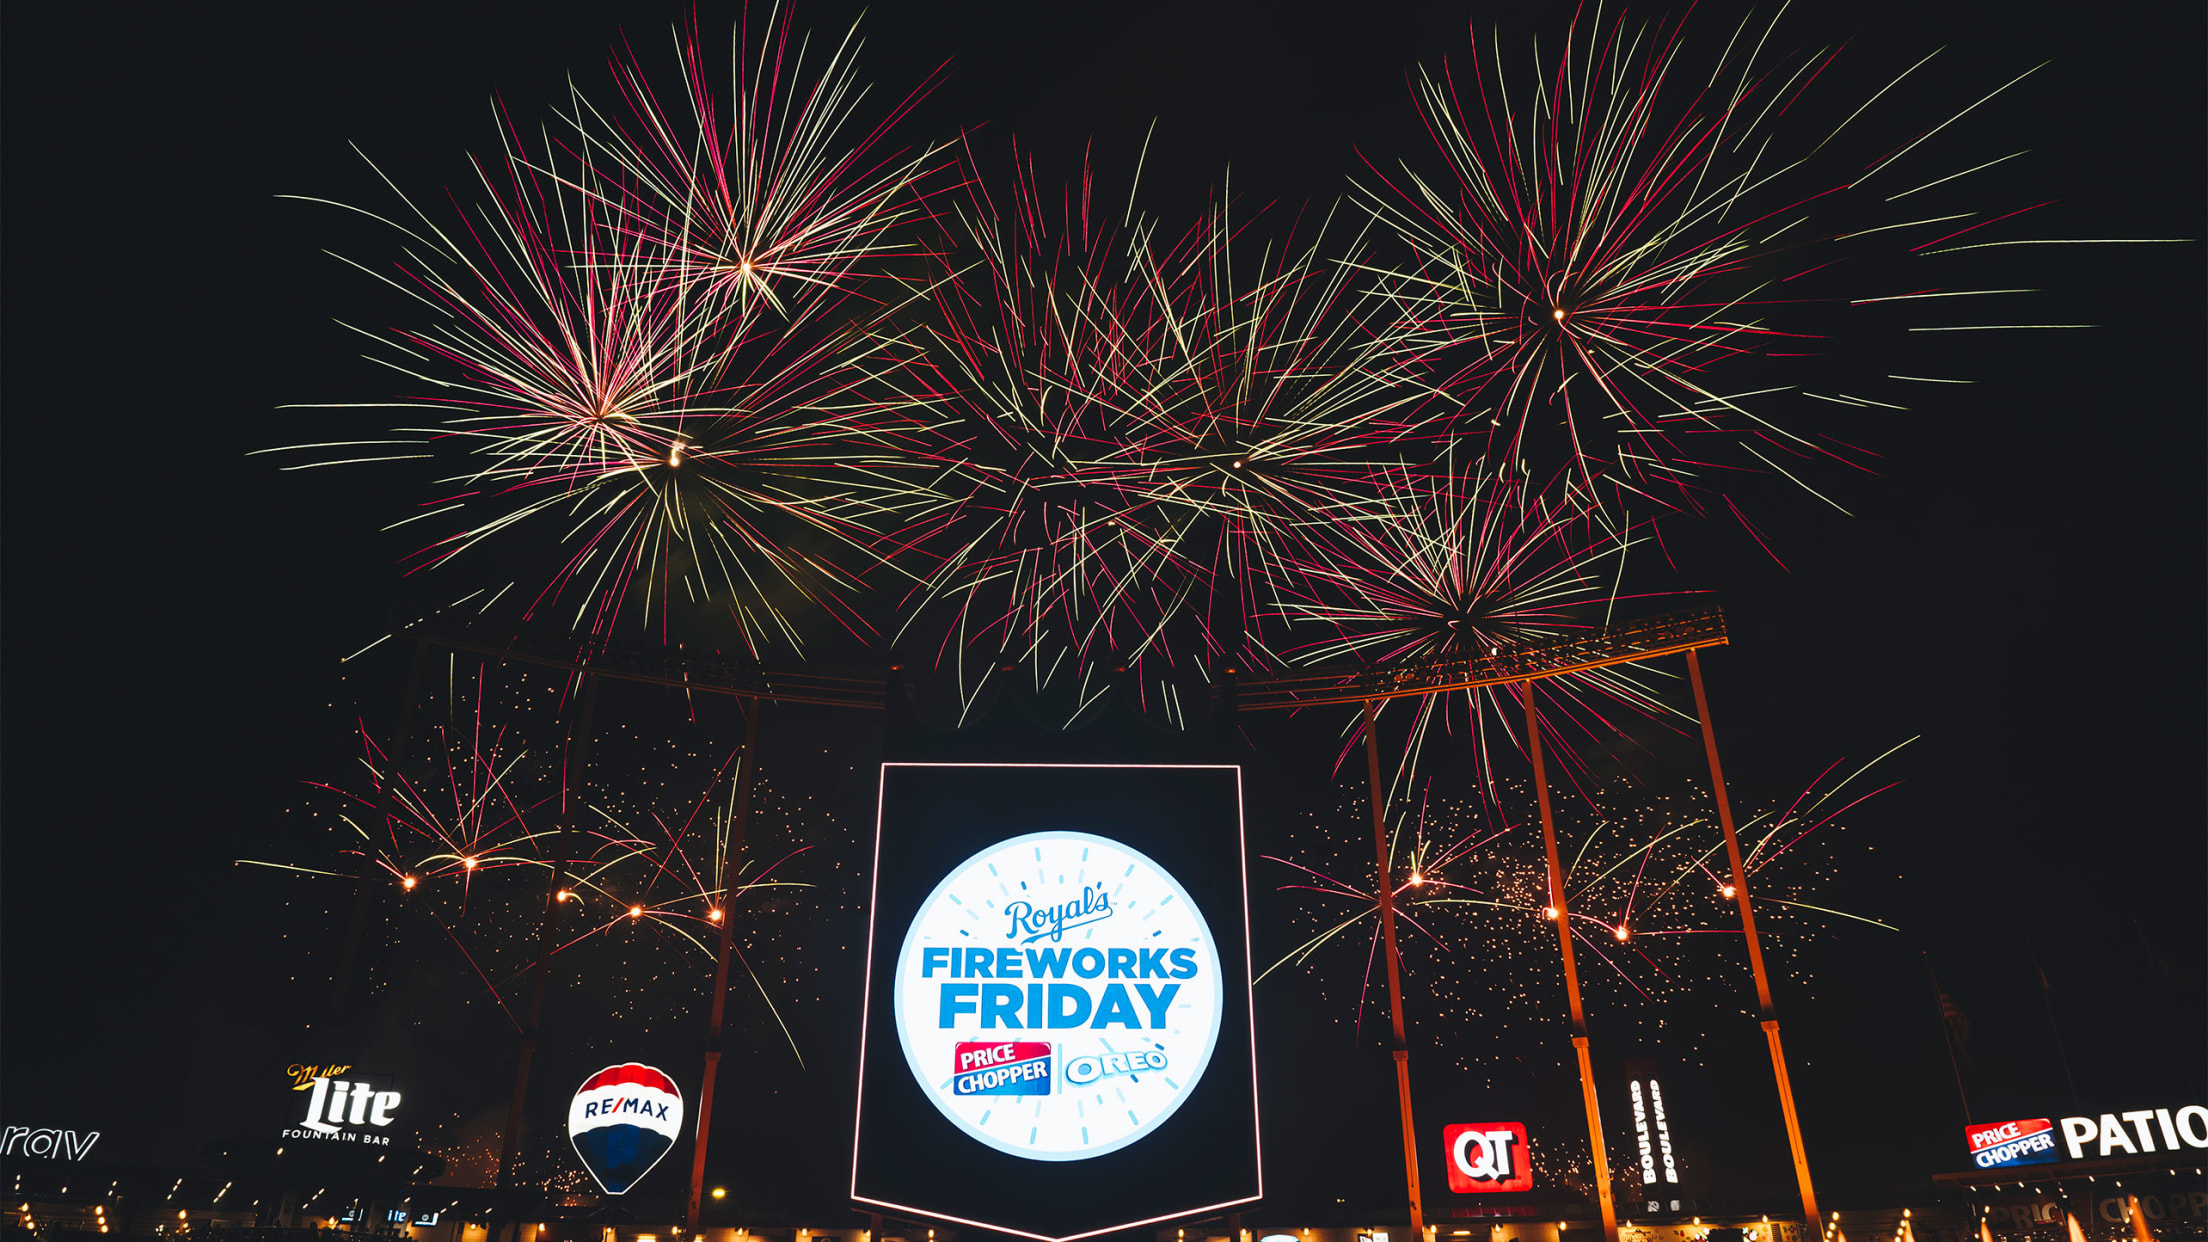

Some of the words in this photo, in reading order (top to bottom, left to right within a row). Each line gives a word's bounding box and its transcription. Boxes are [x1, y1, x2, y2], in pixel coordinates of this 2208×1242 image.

[922, 947, 1198, 979] FIREWORKS
[939, 983, 1181, 1029] FRIDAY
[960, 1044, 1015, 1070] PRICE
[1066, 1051, 1168, 1085] OREO
[286, 1063, 352, 1091] Mller
[957, 1061, 1048, 1094] CHOPPER
[299, 1076, 401, 1134] Lite
[585, 1097, 669, 1121] RE/MAX
[282, 1129, 356, 1142] FOUNTAIN
[363, 1134, 390, 1147] BAR
[1630, 1080, 1657, 1185] BOULEVARD
[1650, 1079, 1679, 1184] BOULEVARD
[1970, 1122, 2022, 1149] PRICE
[2060, 1105, 2208, 1159] PATIO
[1453, 1130, 1513, 1180] QT
[1975, 1133, 2056, 1168] CHOPPER
[1991, 1202, 2065, 1229] PRIC
